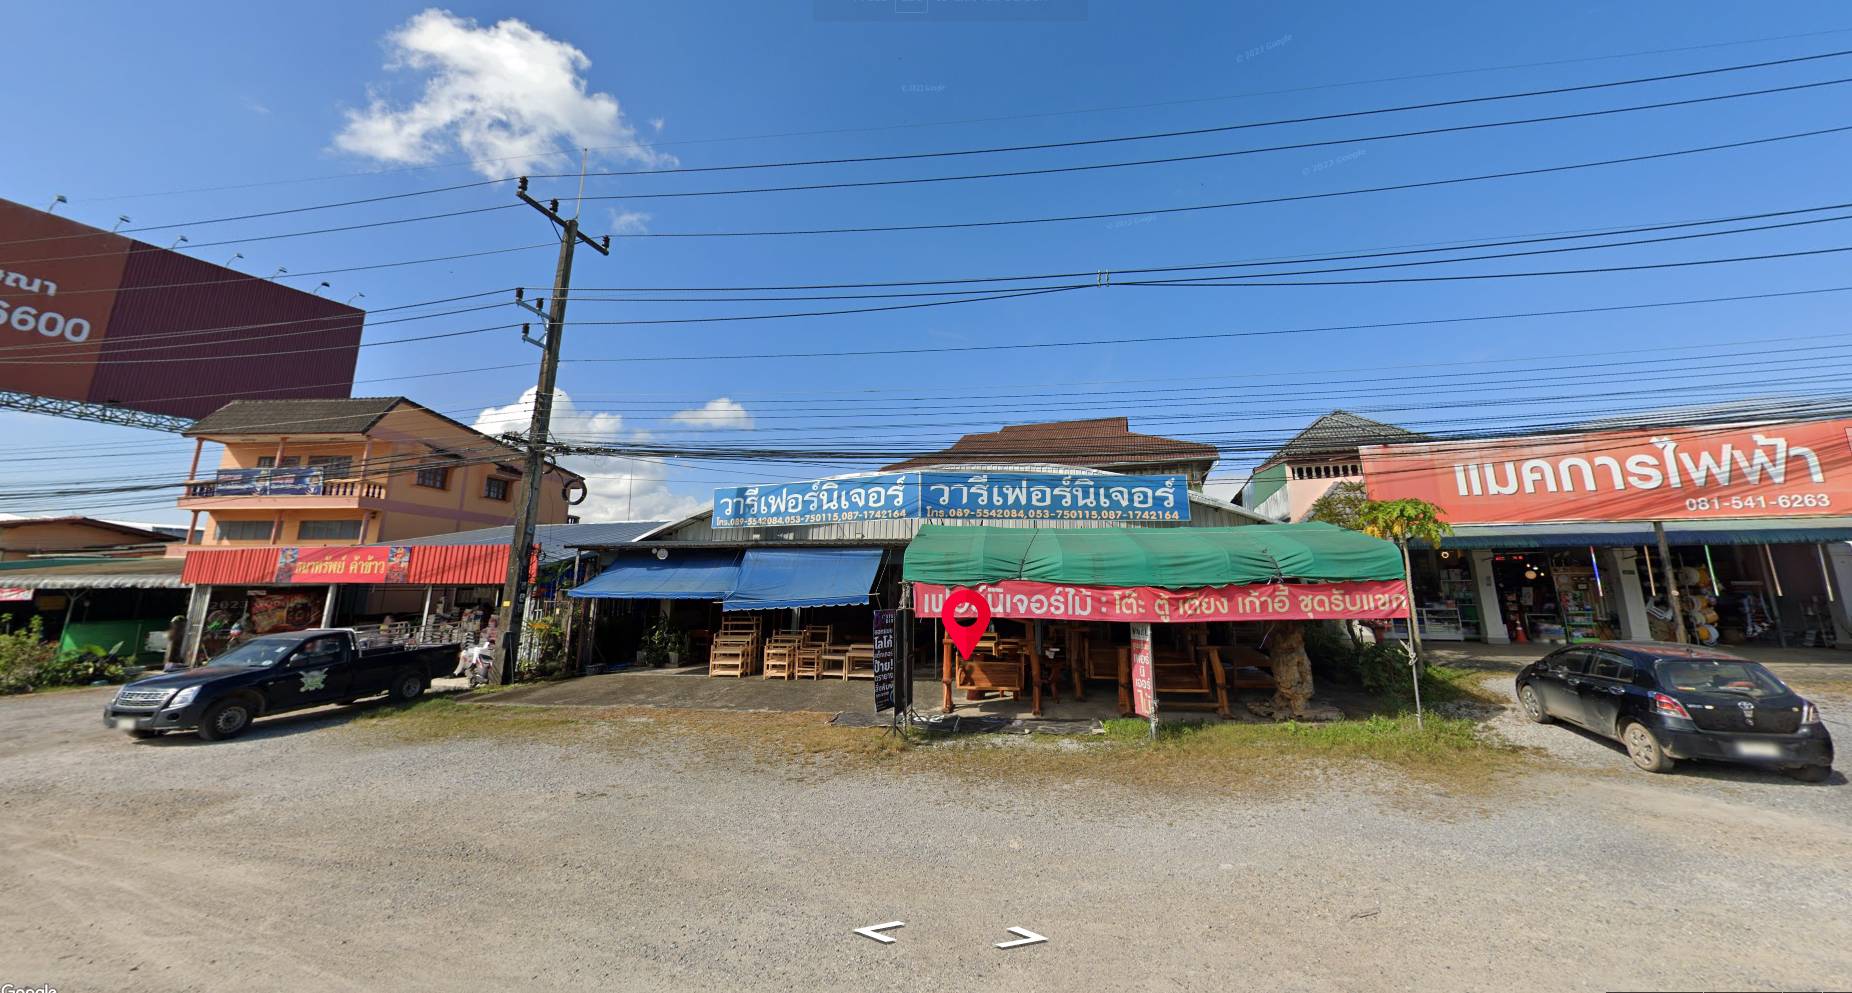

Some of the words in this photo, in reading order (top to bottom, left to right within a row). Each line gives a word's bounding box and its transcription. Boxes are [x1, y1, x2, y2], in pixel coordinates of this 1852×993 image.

[0, 268, 57, 297] ณา
[1454, 435, 1825, 497] แมคการไฟฟ้า
[720, 475, 906, 516] วารีเฟอร์นิเจอร์
[930, 475, 1176, 508] วารีเฟอร์นิเจอร์
[1685, 494, 1831, 511] 081-541-6263
[349, 555, 385, 574] ค้าข้าว
[1113, 591, 1145, 615] โต๊ะ
[1154, 593, 1170, 622] ตู้
[1178, 592, 1229, 615] เตียง
[1238, 584, 1290, 614] เก้าอี้
[1299, 589, 1407, 619] ชุดรับแขก
[874, 635, 893, 650] โลโก้
[874, 659, 893, 673] ป้าย!
